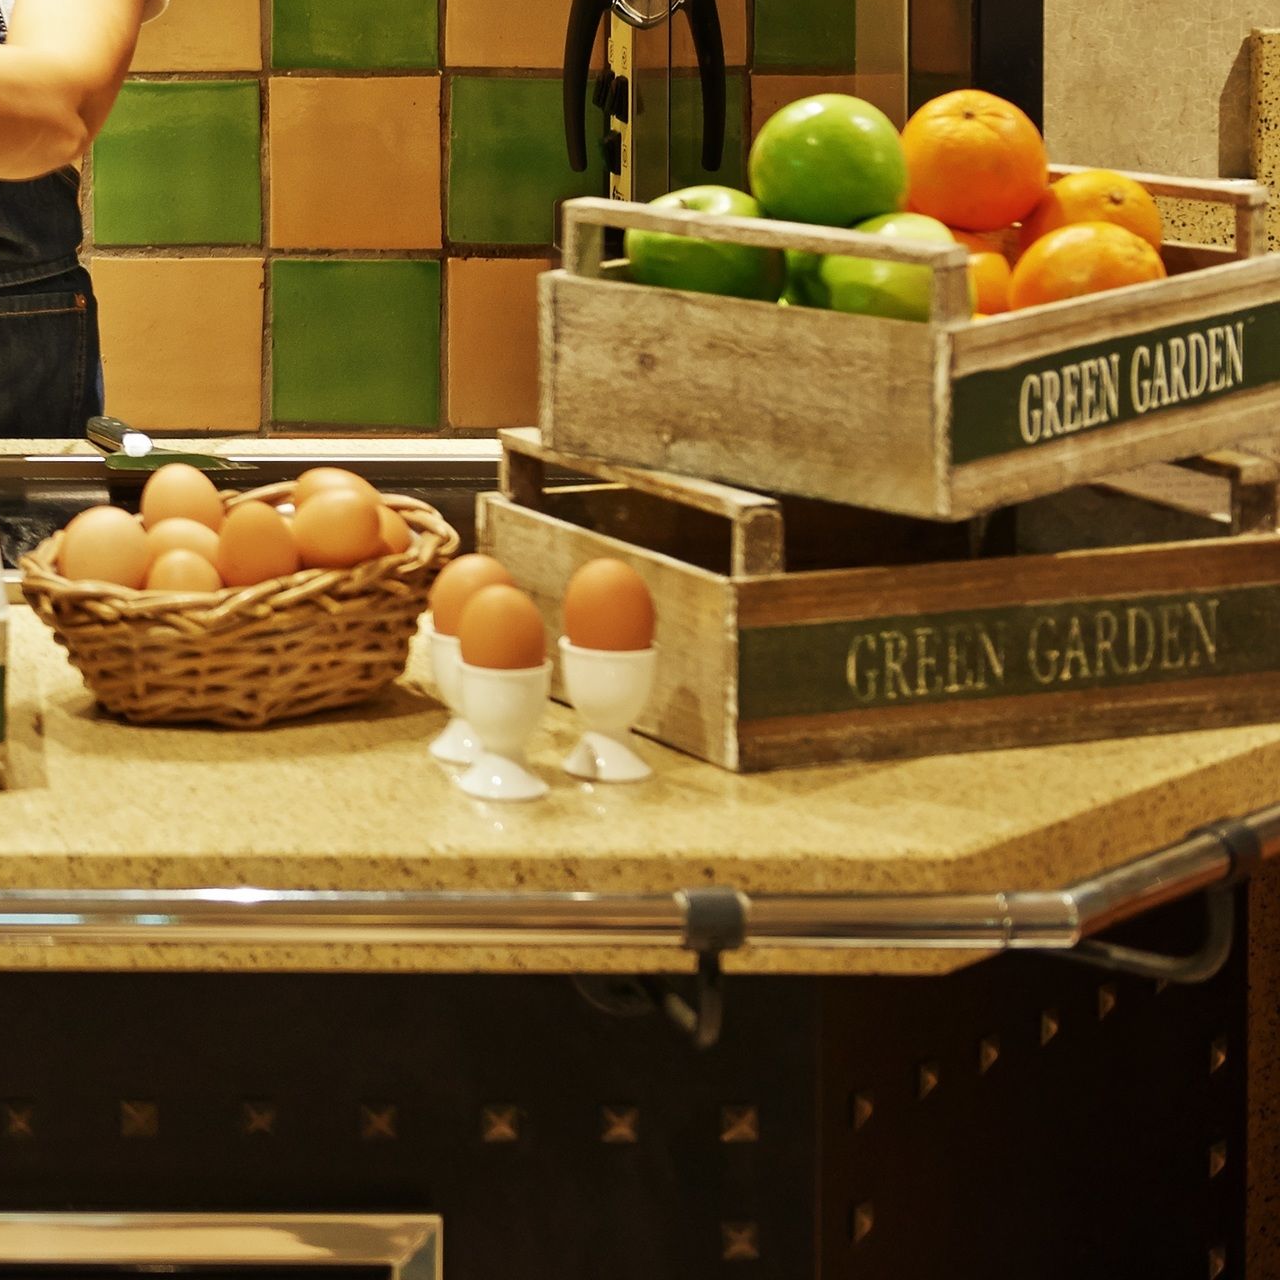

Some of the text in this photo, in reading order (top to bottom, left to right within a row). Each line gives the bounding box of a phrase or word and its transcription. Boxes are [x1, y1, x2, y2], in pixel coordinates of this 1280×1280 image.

[1019, 321, 1244, 444] GREEN GARDEN
[845, 599, 1220, 702] GREEN GARDEN
